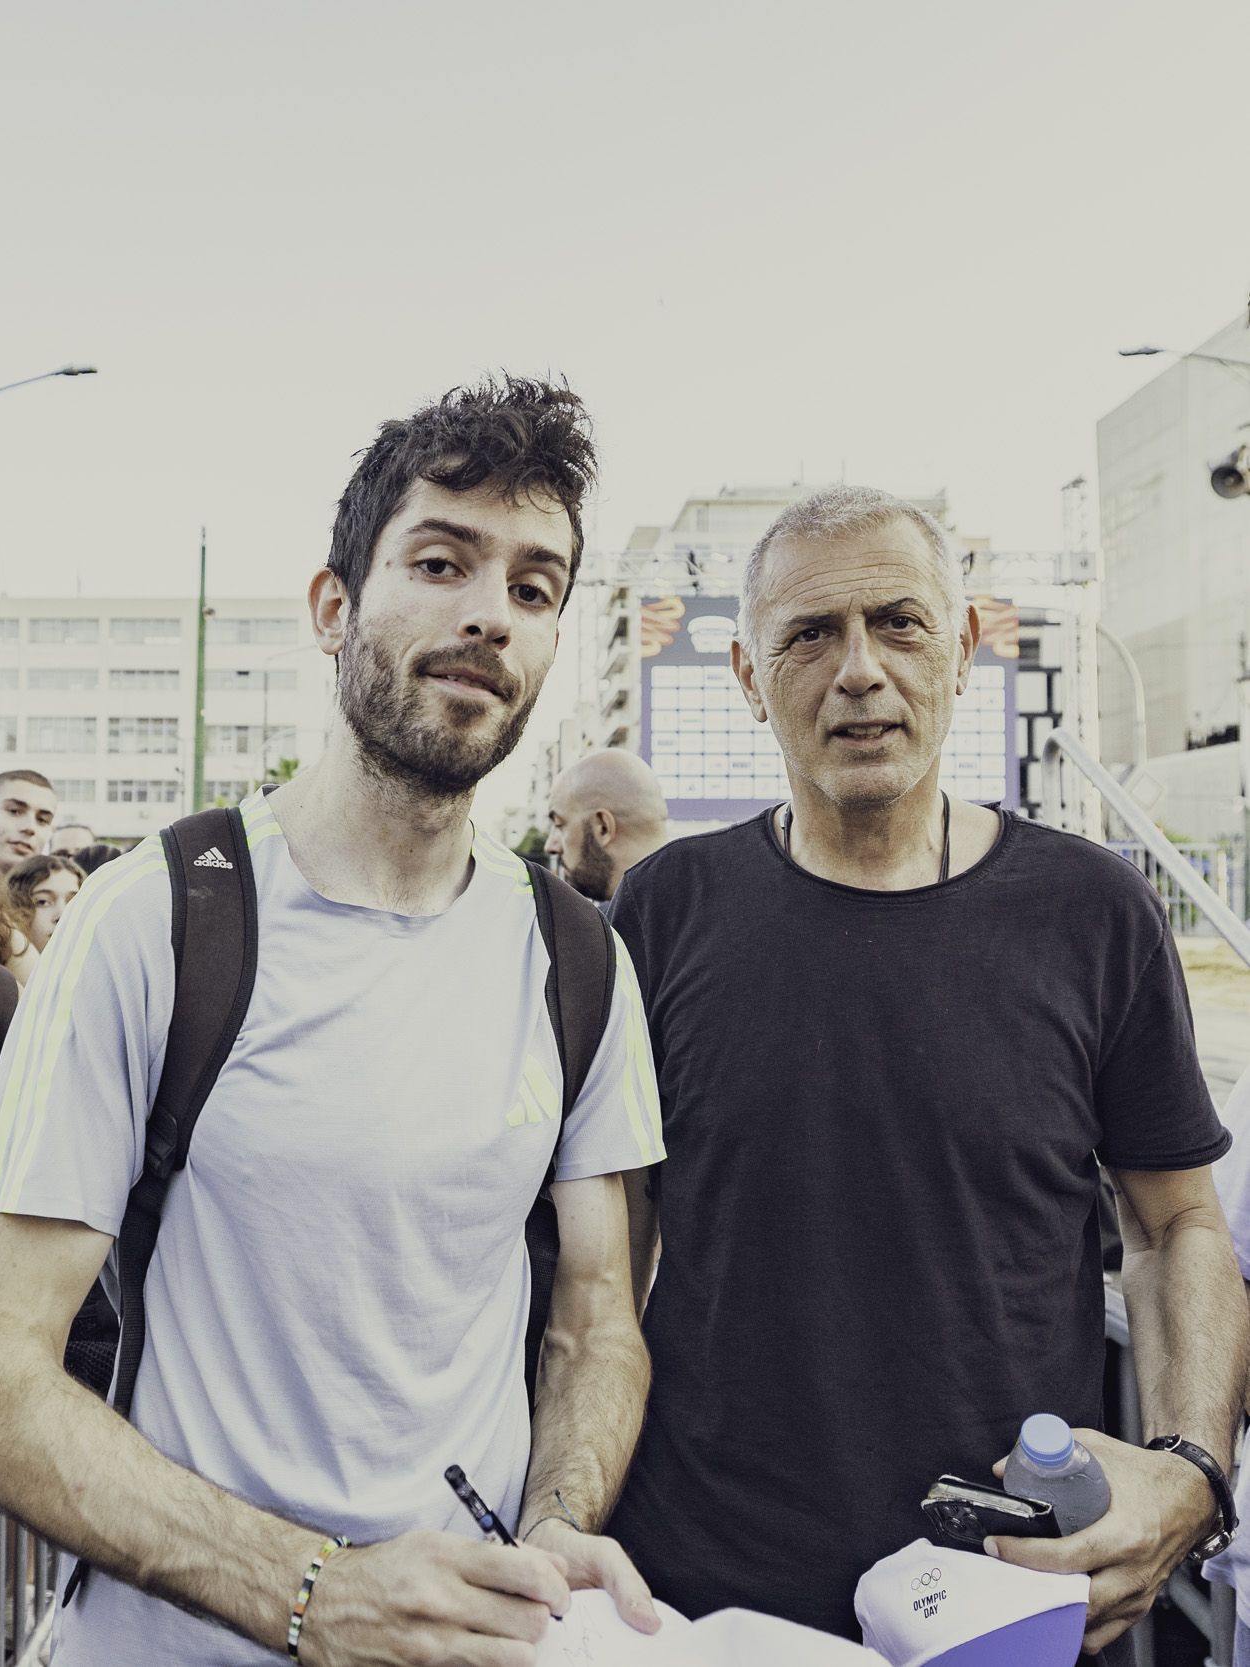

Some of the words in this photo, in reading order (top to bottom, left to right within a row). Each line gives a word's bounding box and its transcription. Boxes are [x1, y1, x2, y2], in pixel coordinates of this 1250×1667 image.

[193, 859, 234, 870] adidas
[913, 1589, 947, 1611] OLYMPIC
[923, 1603, 939, 1619] DAY
